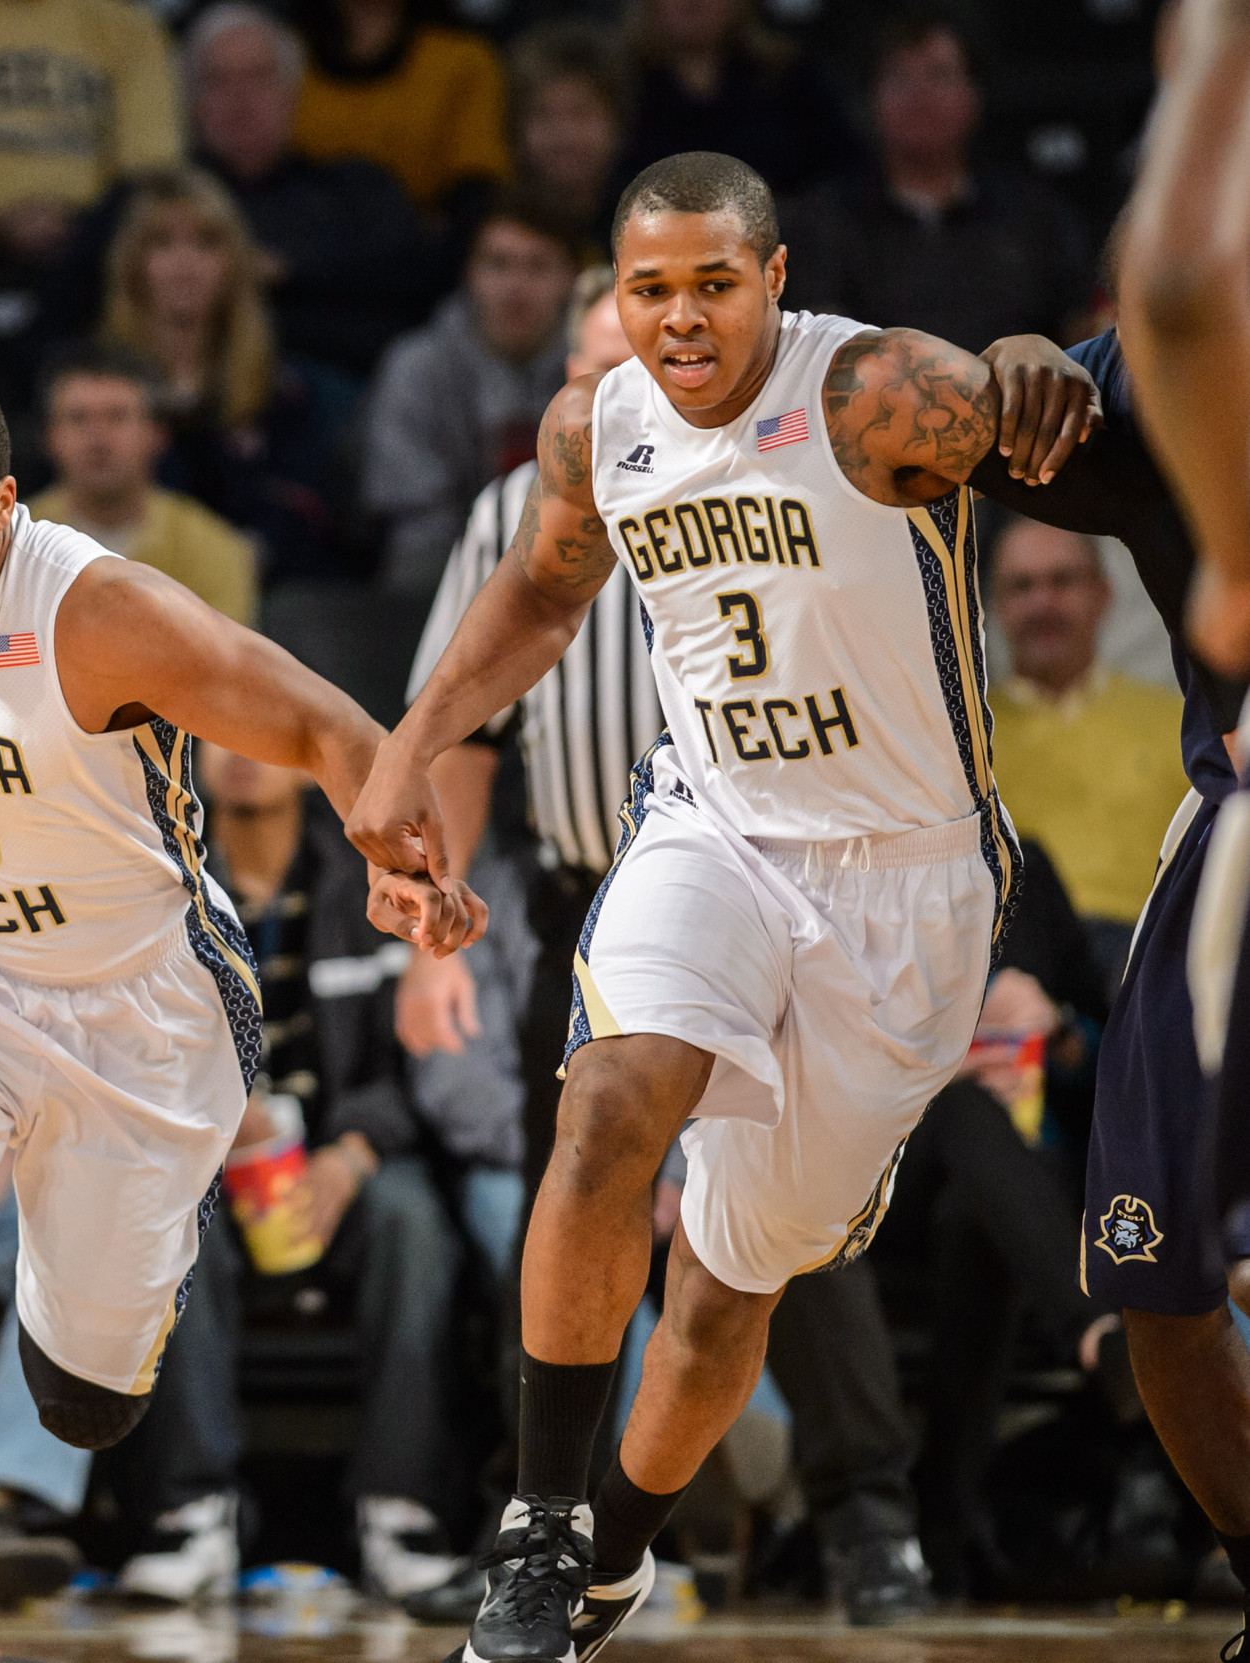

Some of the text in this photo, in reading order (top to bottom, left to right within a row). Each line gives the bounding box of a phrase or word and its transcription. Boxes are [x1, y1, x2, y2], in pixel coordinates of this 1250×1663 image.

[616, 460, 655, 474] RUSSELL
[618, 495, 823, 583] GEORGIA
[714, 589, 771, 682] 3
[693, 685, 862, 766] TECH
